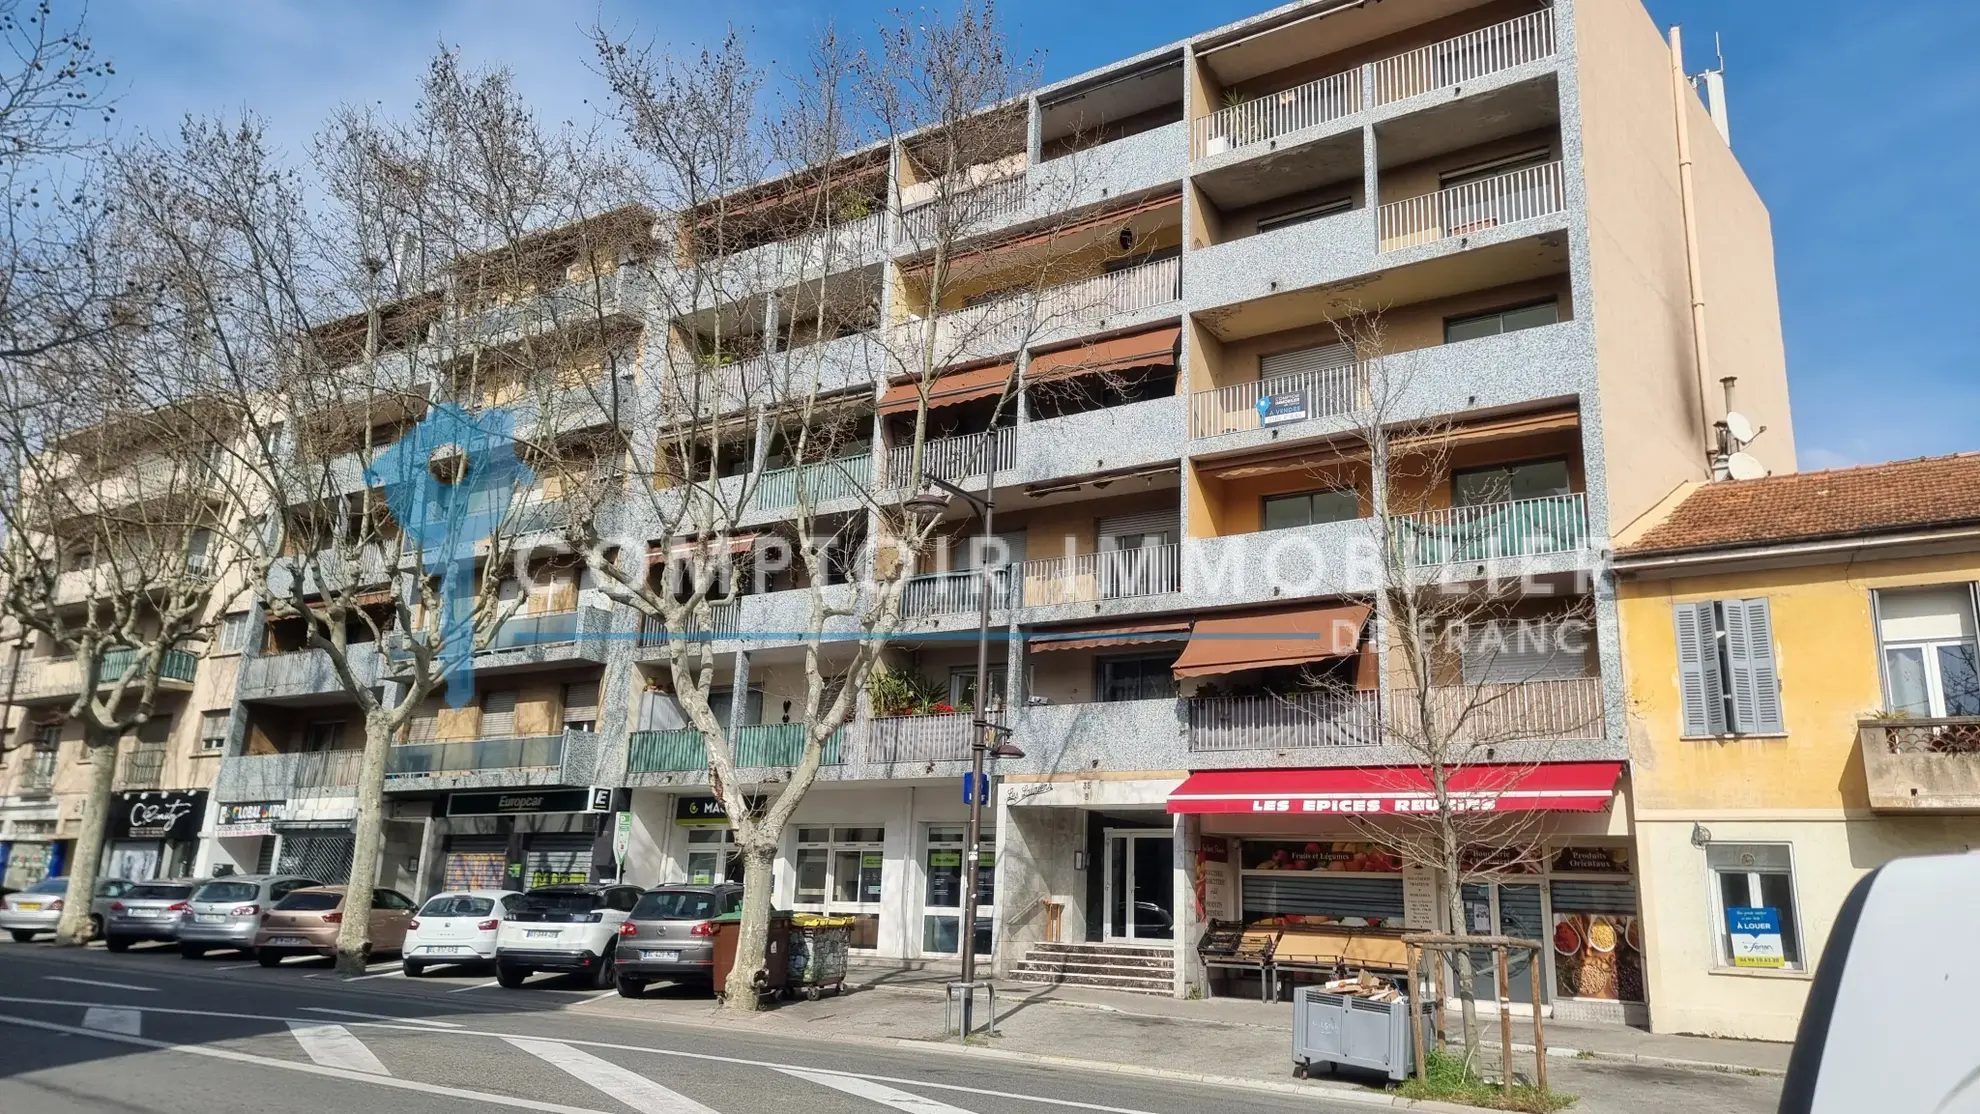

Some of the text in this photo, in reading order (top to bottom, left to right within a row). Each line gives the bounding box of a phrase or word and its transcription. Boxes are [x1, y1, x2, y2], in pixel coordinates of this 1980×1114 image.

[1082, 782, 1092, 790] 35
[595, 790, 608, 805] E
[498, 796, 544, 810] Europcar
[1252, 800, 1290, 812] LES
[1302, 799, 1381, 812] EPICES
[1291, 852, 1311, 860] Fruits
[1320, 852, 1350, 862] Légumes
[1572, 852, 1607, 860] Produits
[1569, 860, 1611, 868] Orientaux
[1744, 922, 1771, 930] LOUER
